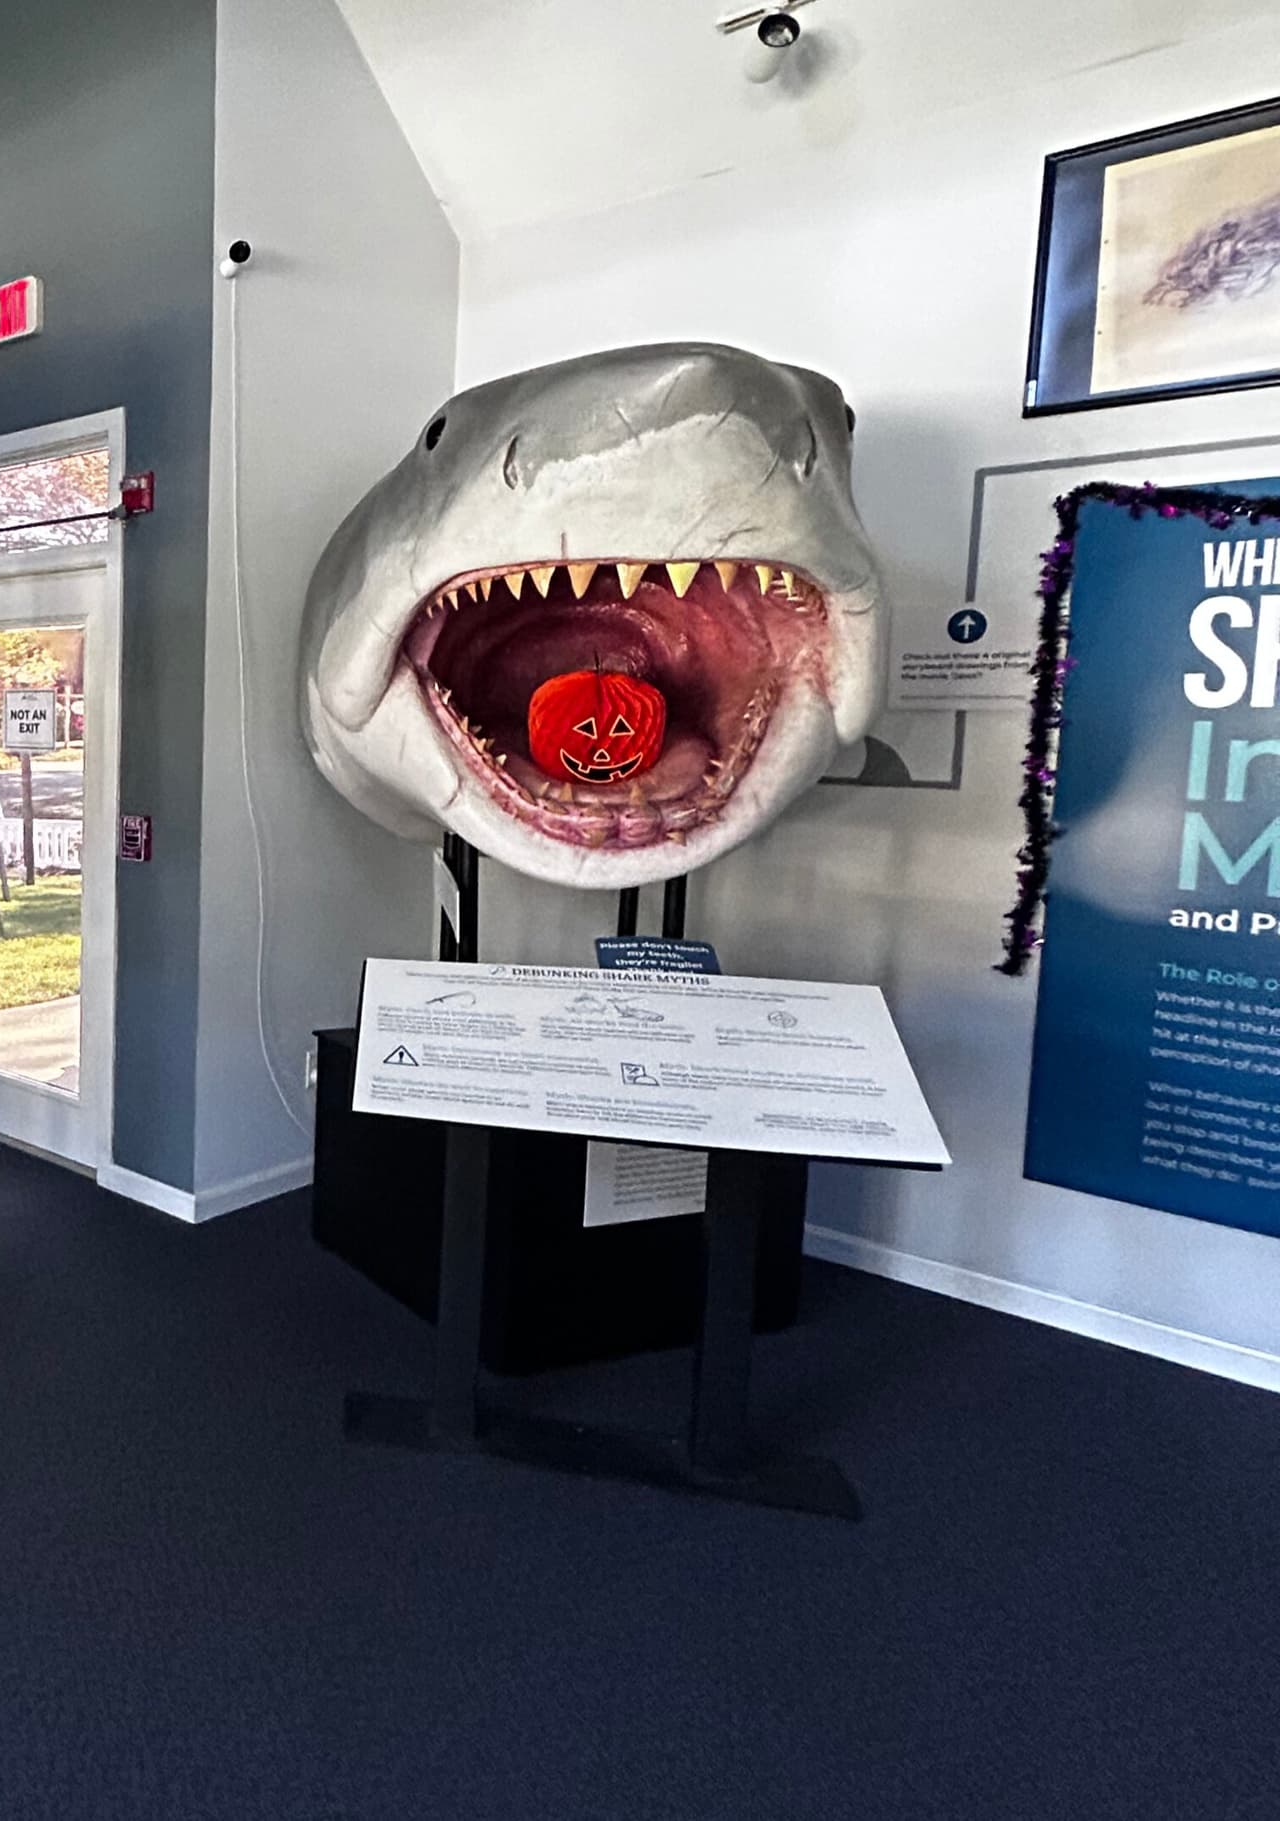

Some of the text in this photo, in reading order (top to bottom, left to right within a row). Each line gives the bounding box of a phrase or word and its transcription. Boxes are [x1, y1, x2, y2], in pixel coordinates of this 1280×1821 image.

[10, 709, 47, 721] NOT AN
[19, 722, 40, 734] EXIT
[1168, 909, 1280, 935] and P
[512, 968, 600, 980] DEBUNKING
[602, 971, 653, 983] SHARK
[656, 974, 711, 986] MYTHS
[1159, 962, 1280, 991] The Role o
[1147, 1080, 1193, 1097] When
